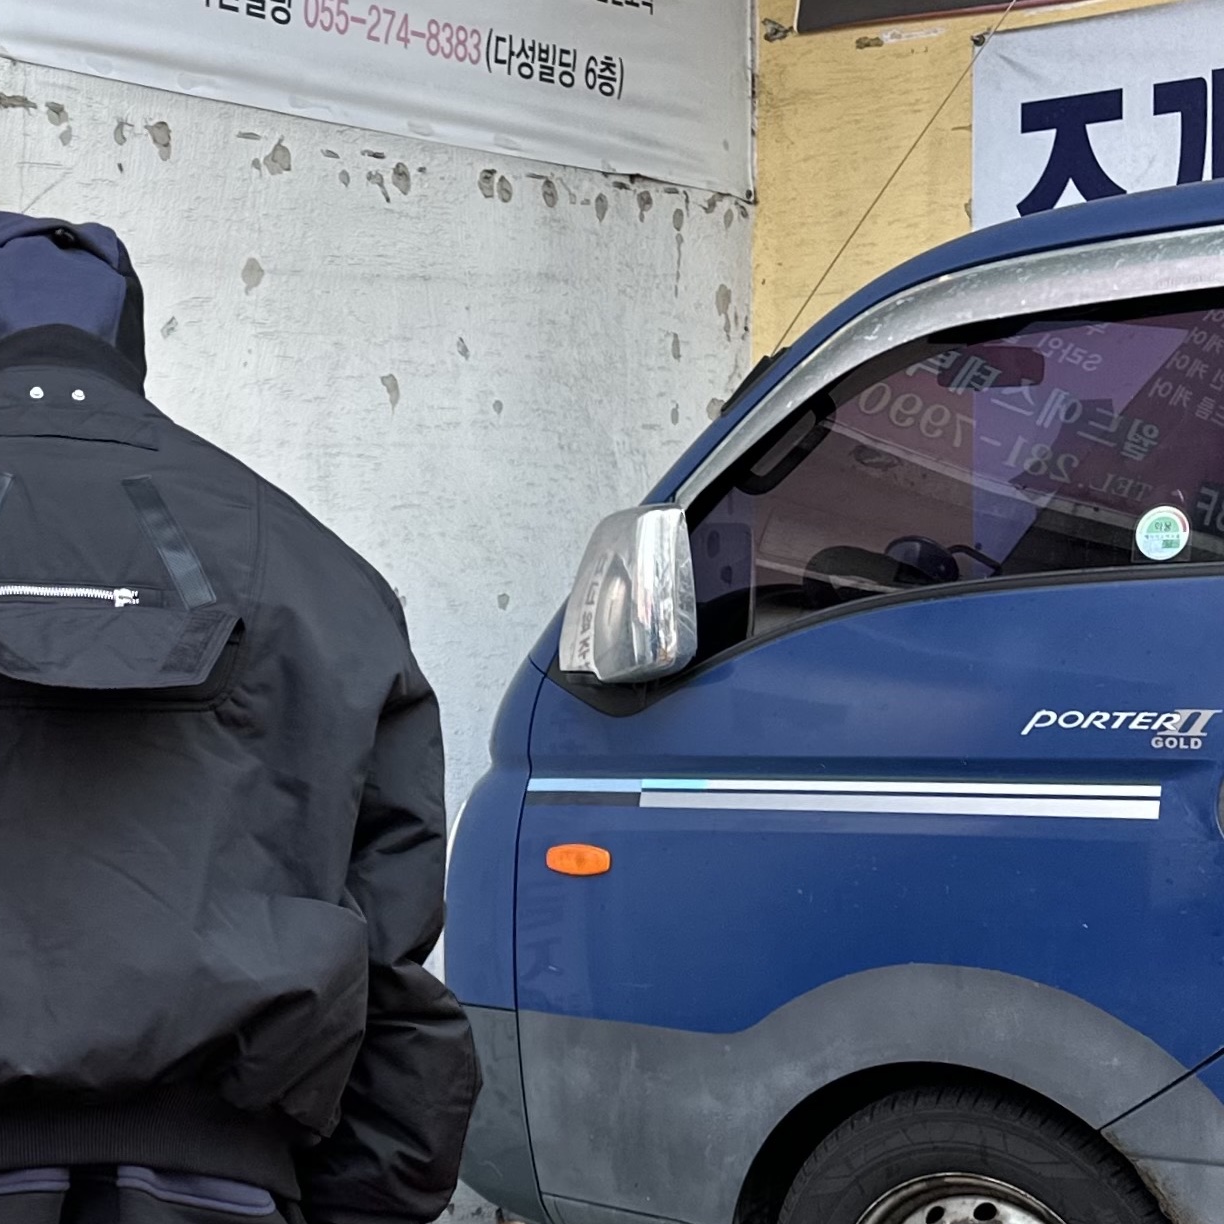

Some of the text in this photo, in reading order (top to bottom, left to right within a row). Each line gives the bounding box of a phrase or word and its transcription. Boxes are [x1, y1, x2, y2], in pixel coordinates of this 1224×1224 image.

[303, 0, 482, 65] 055-274-8383
[485, 28, 577, 88] (다성빌딩
[584, 55, 624, 100] 6층)
[1020, 709, 1181, 736] PORTER
[1151, 737, 1203, 750] GOLD
